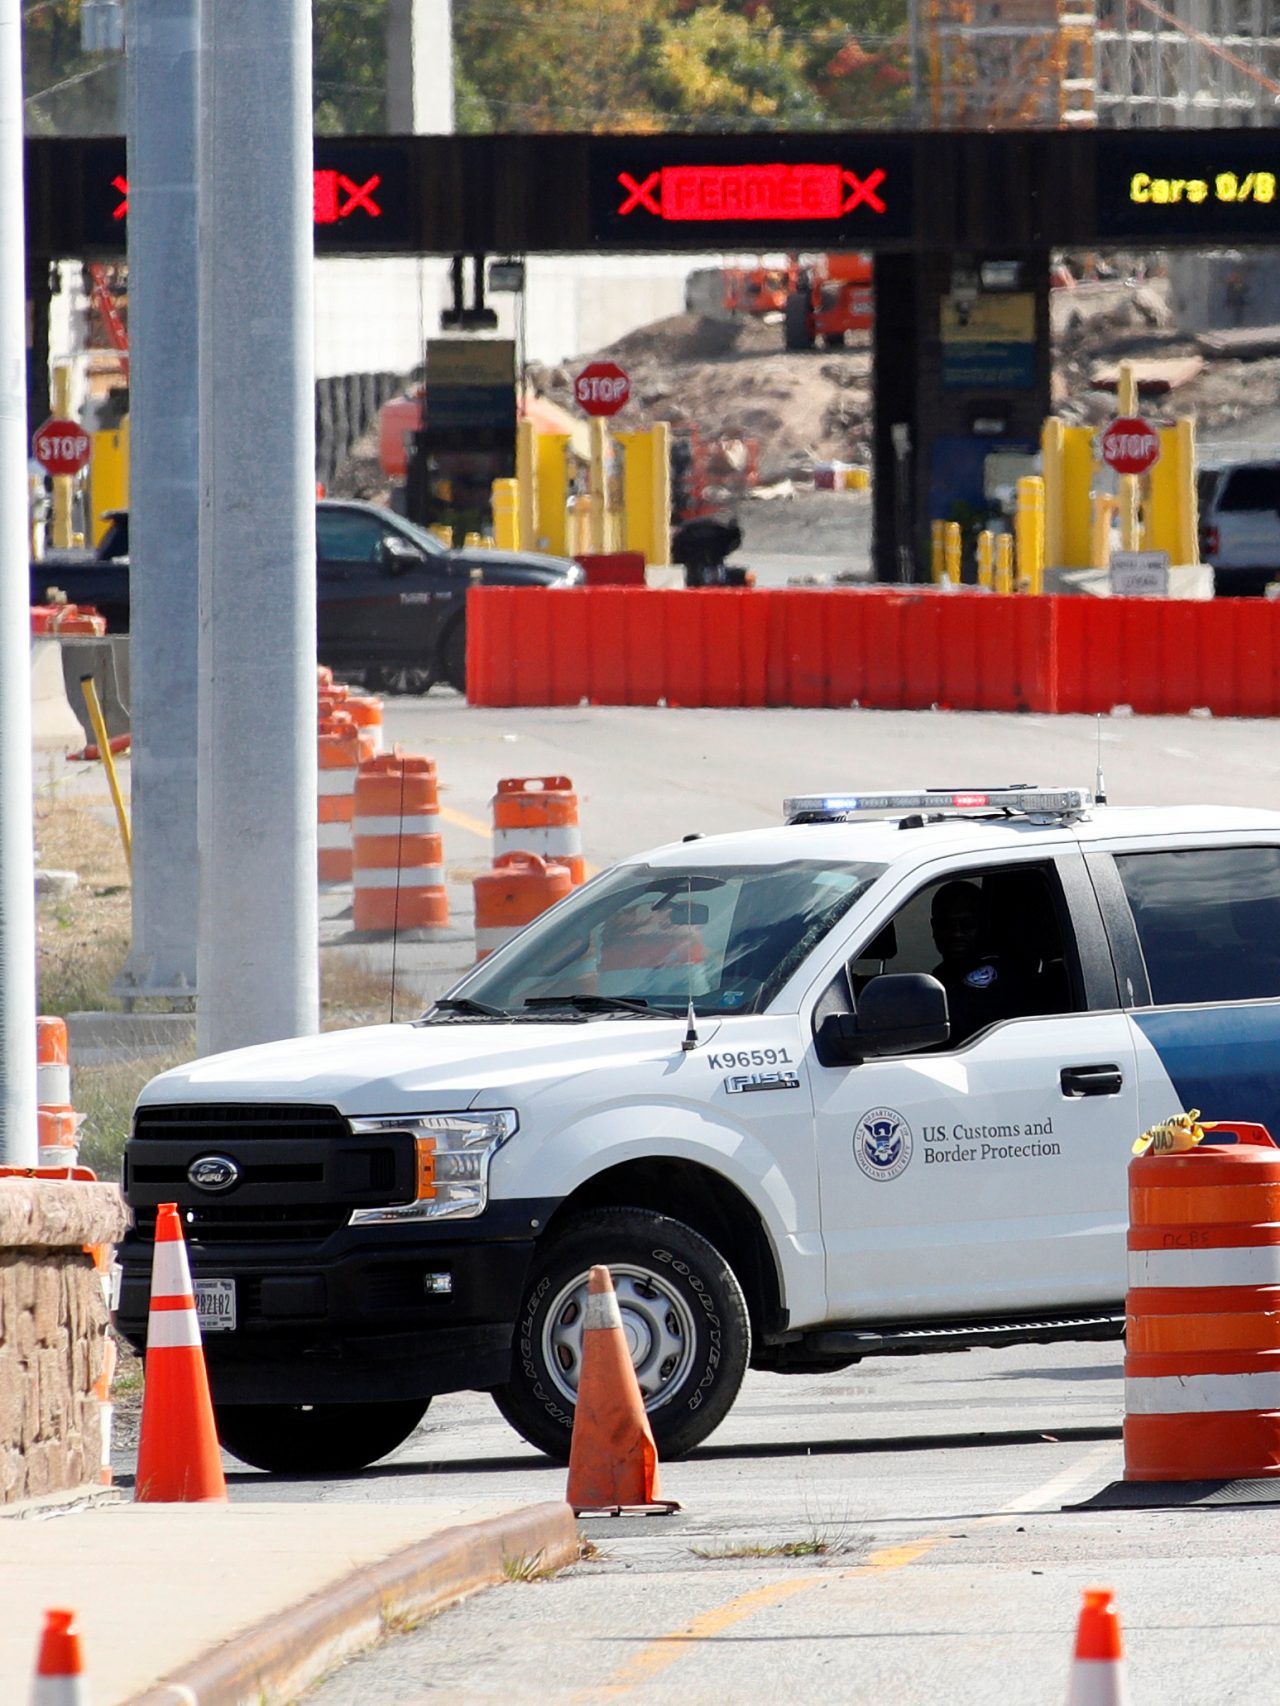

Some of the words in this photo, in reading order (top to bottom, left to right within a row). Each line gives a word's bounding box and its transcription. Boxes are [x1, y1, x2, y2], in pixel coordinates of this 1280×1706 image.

[1130, 172, 1208, 203] Cars
[579, 376, 627, 401] STOP
[39, 436, 88, 460] STOP
[1104, 434, 1157, 459] STOP
[707, 1047, 793, 1070] K96591
[923, 1126, 949, 1142] U.S.
[953, 1124, 1021, 1141] Customs
[1024, 1117, 1054, 1136] and
[924, 1144, 977, 1163] Border
[980, 1140, 1061, 1160] Protection
[651, 1249, 721, 1411] GOODYEAR
